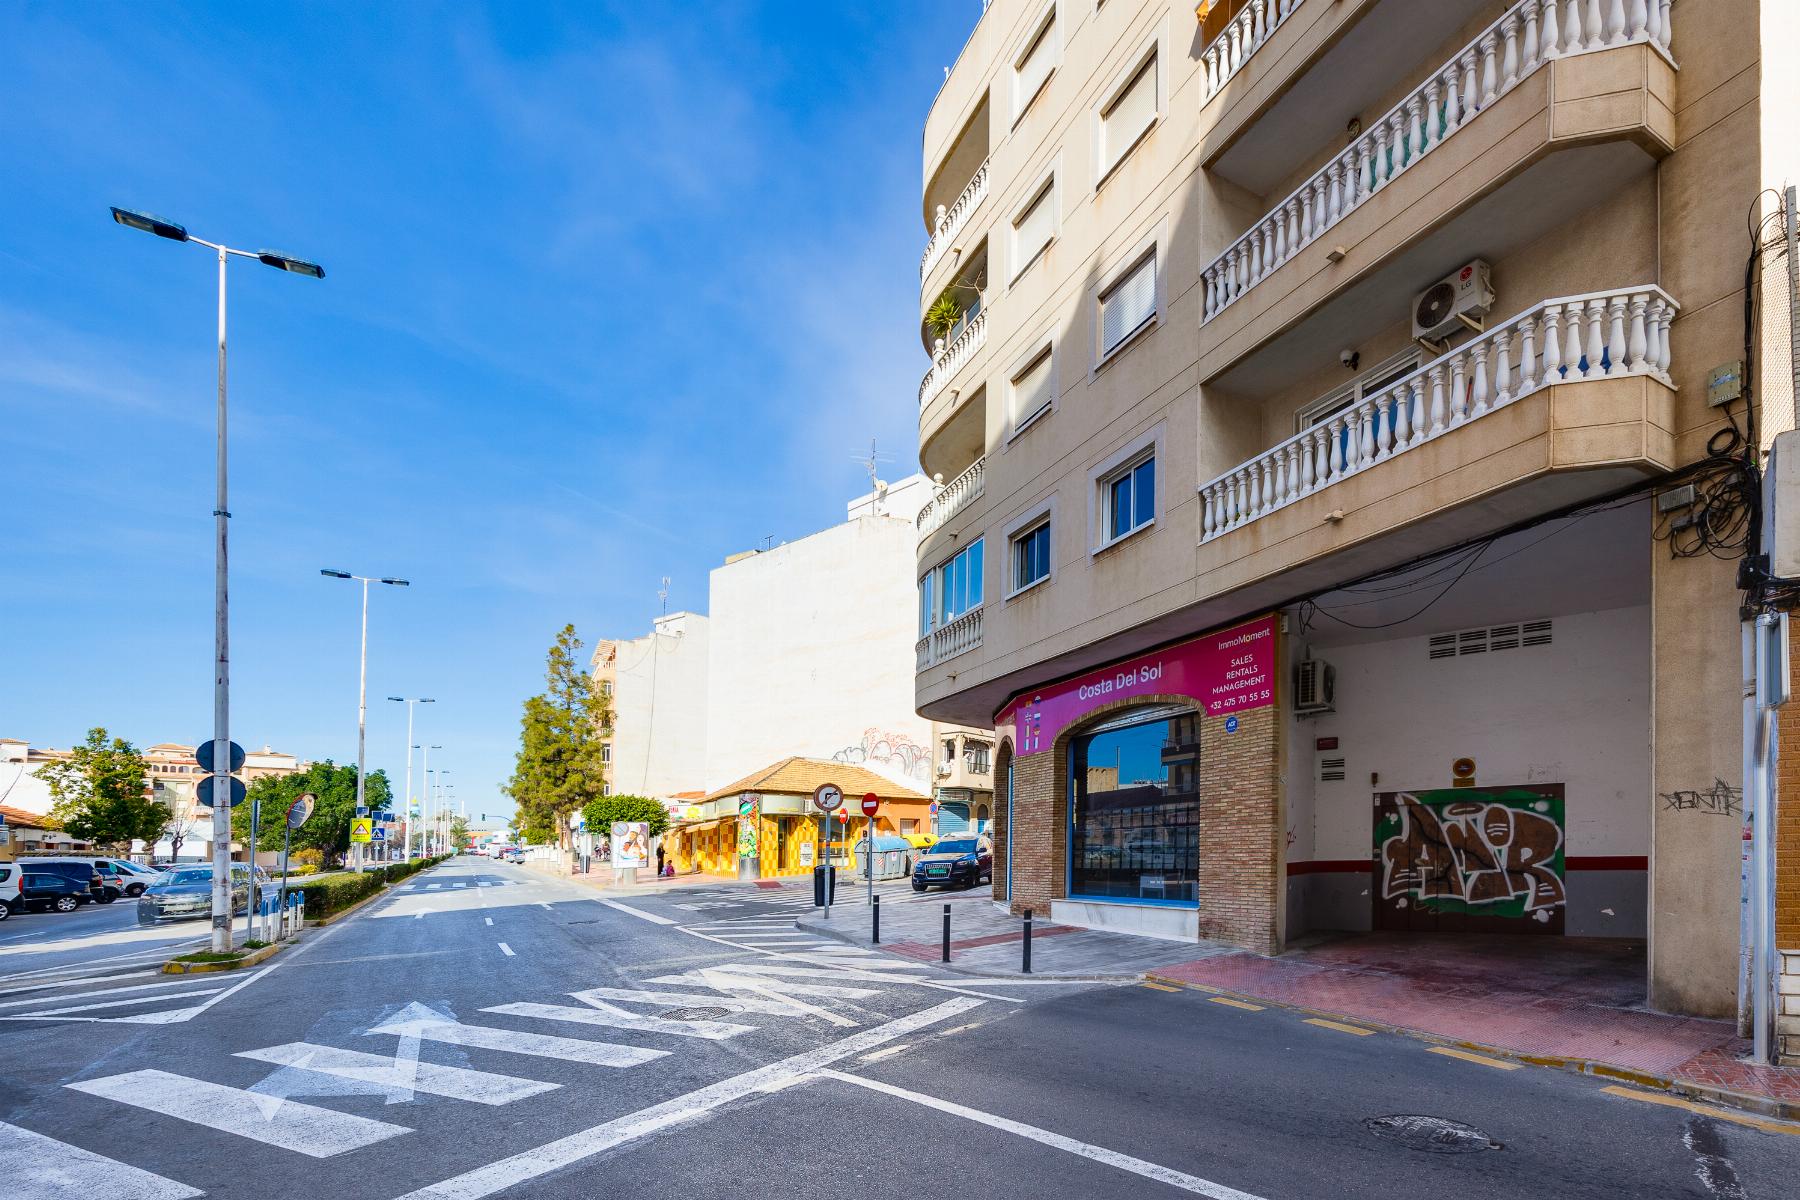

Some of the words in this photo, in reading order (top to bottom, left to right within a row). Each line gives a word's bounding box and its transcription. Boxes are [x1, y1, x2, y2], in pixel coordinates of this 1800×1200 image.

[1461, 281, 1472, 290] LG
[1218, 627, 1270, 650] ImmoMoment
[1230, 654, 1253, 667] SALES
[1079, 679, 1113, 700] Costa
[1116, 668, 1136, 689] Del
[1140, 661, 1162, 682] Sol
[1226, 665, 1258, 680] RENTALS
[1212, 675, 1266, 695] MANAGEMENT
[1210, 700, 1222, 710] +32
[1224, 698, 1236, 707] 475
[1238, 695, 1247, 704] 70
[1249, 692, 1258, 702] 55
[1260, 689, 1270, 699] 55
